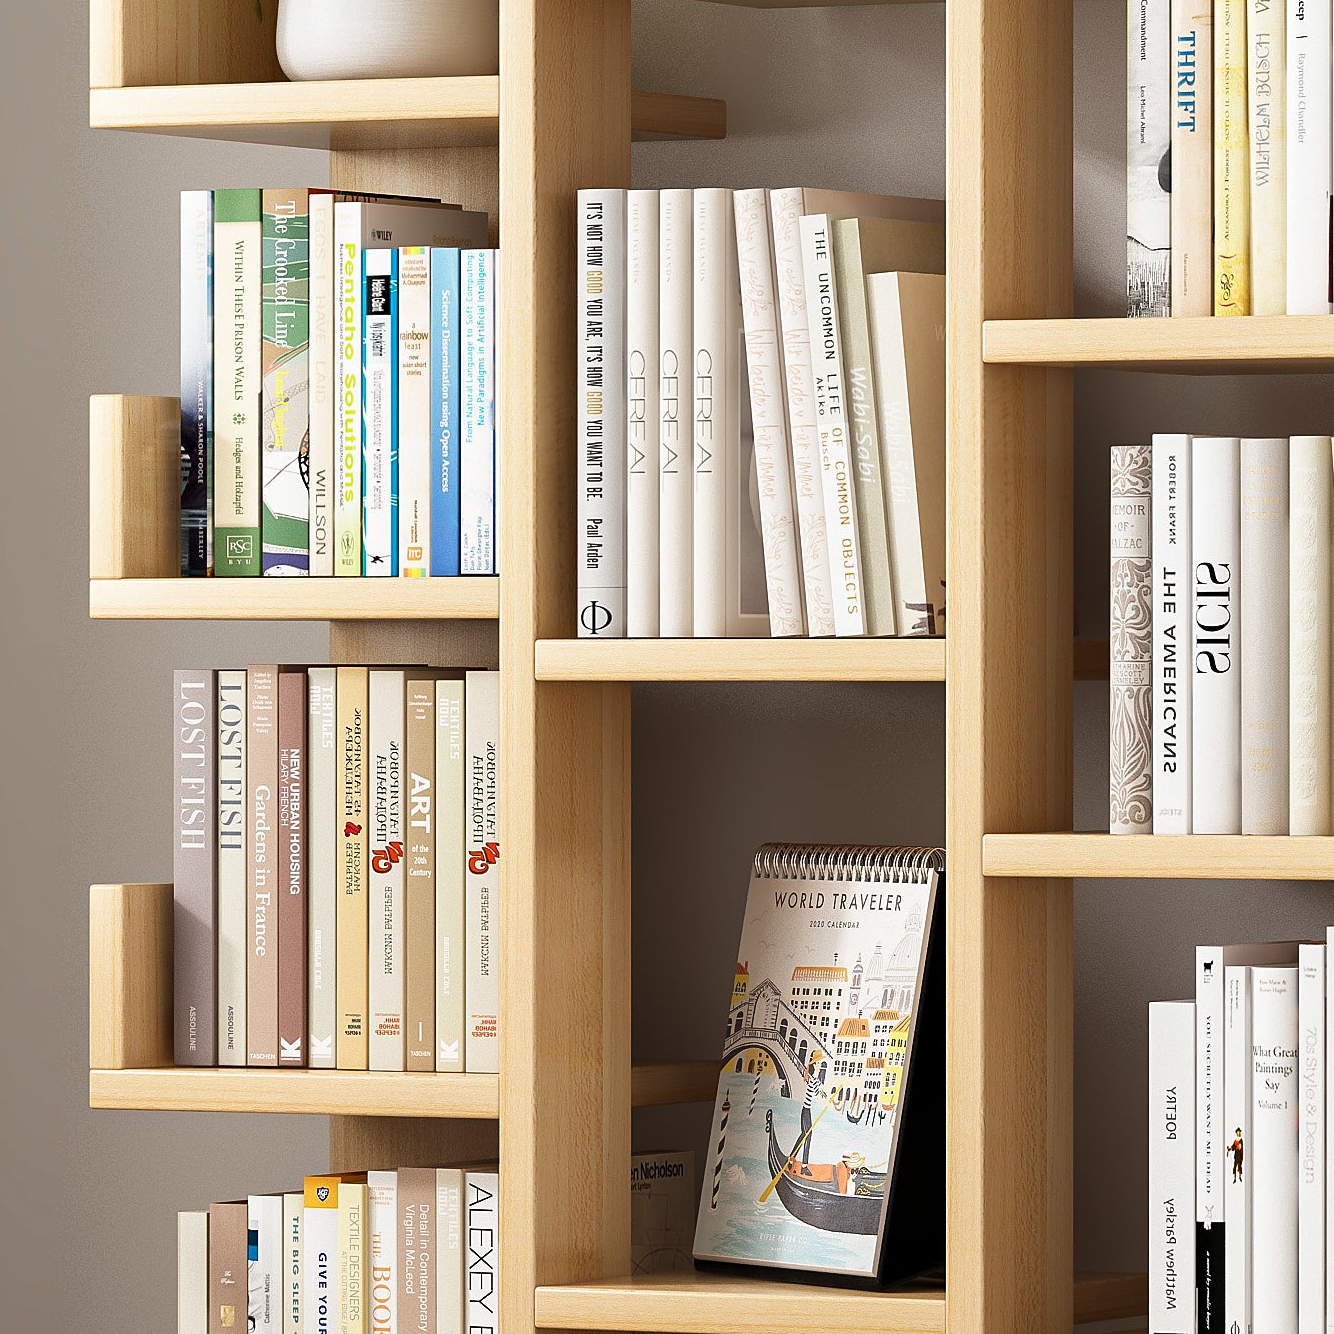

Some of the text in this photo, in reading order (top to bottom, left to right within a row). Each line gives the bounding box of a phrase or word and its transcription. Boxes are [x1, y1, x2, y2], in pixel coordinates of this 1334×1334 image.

[1177, 30, 1196, 133] THRIFT
[1255, 32, 1272, 187] WILHELM BUSCH
[273, 200, 297, 349] The Crooked Line
[375, 229, 394, 242] WILEY
[234, 285, 245, 320] THESE
[344, 243, 357, 503] Pentaho Solutions
[438, 289, 451, 493] Science Dissemination using Open Access
[584, 202, 604, 502] IT'S NOT HOW GOOD YOU ARE, IT'S HOW GOOD YOU WANT TO BE.
[814, 228, 858, 615] THE UNCOMMON LIFE OF COMMON OBJECTS
[848, 364, 876, 485] Wabi-Sabi
[315, 469, 327, 555] WILLSON
[586, 518, 601, 569] Paul Arden
[179, 680, 207, 850] LOST FISH
[218, 685, 243, 850] LOST FISH
[410, 772, 432, 835] ART
[289, 745, 302, 897] NEW URBAN HOUSING
[253, 783, 272, 957] Gardens in France
[774, 891, 902, 912] WORLD TRAVELER
[809, 920, 860, 929] 2020 CALENDAR
[188, 1005, 197, 1051] ASSOULINE
[292, 1215, 300, 1243] THE
[370, 1232, 382, 1258] THE
[418, 1204, 431, 1236] Detail
[419, 1239, 430, 1249] in
[468, 1182, 494, 1314] ALEXEY
[292, 1249, 300, 1276] BIG
[318, 1252, 328, 1289] GIVE
[417, 1252, 430, 1332] Contemporary
[292, 1282, 300, 1324] SLEEP
